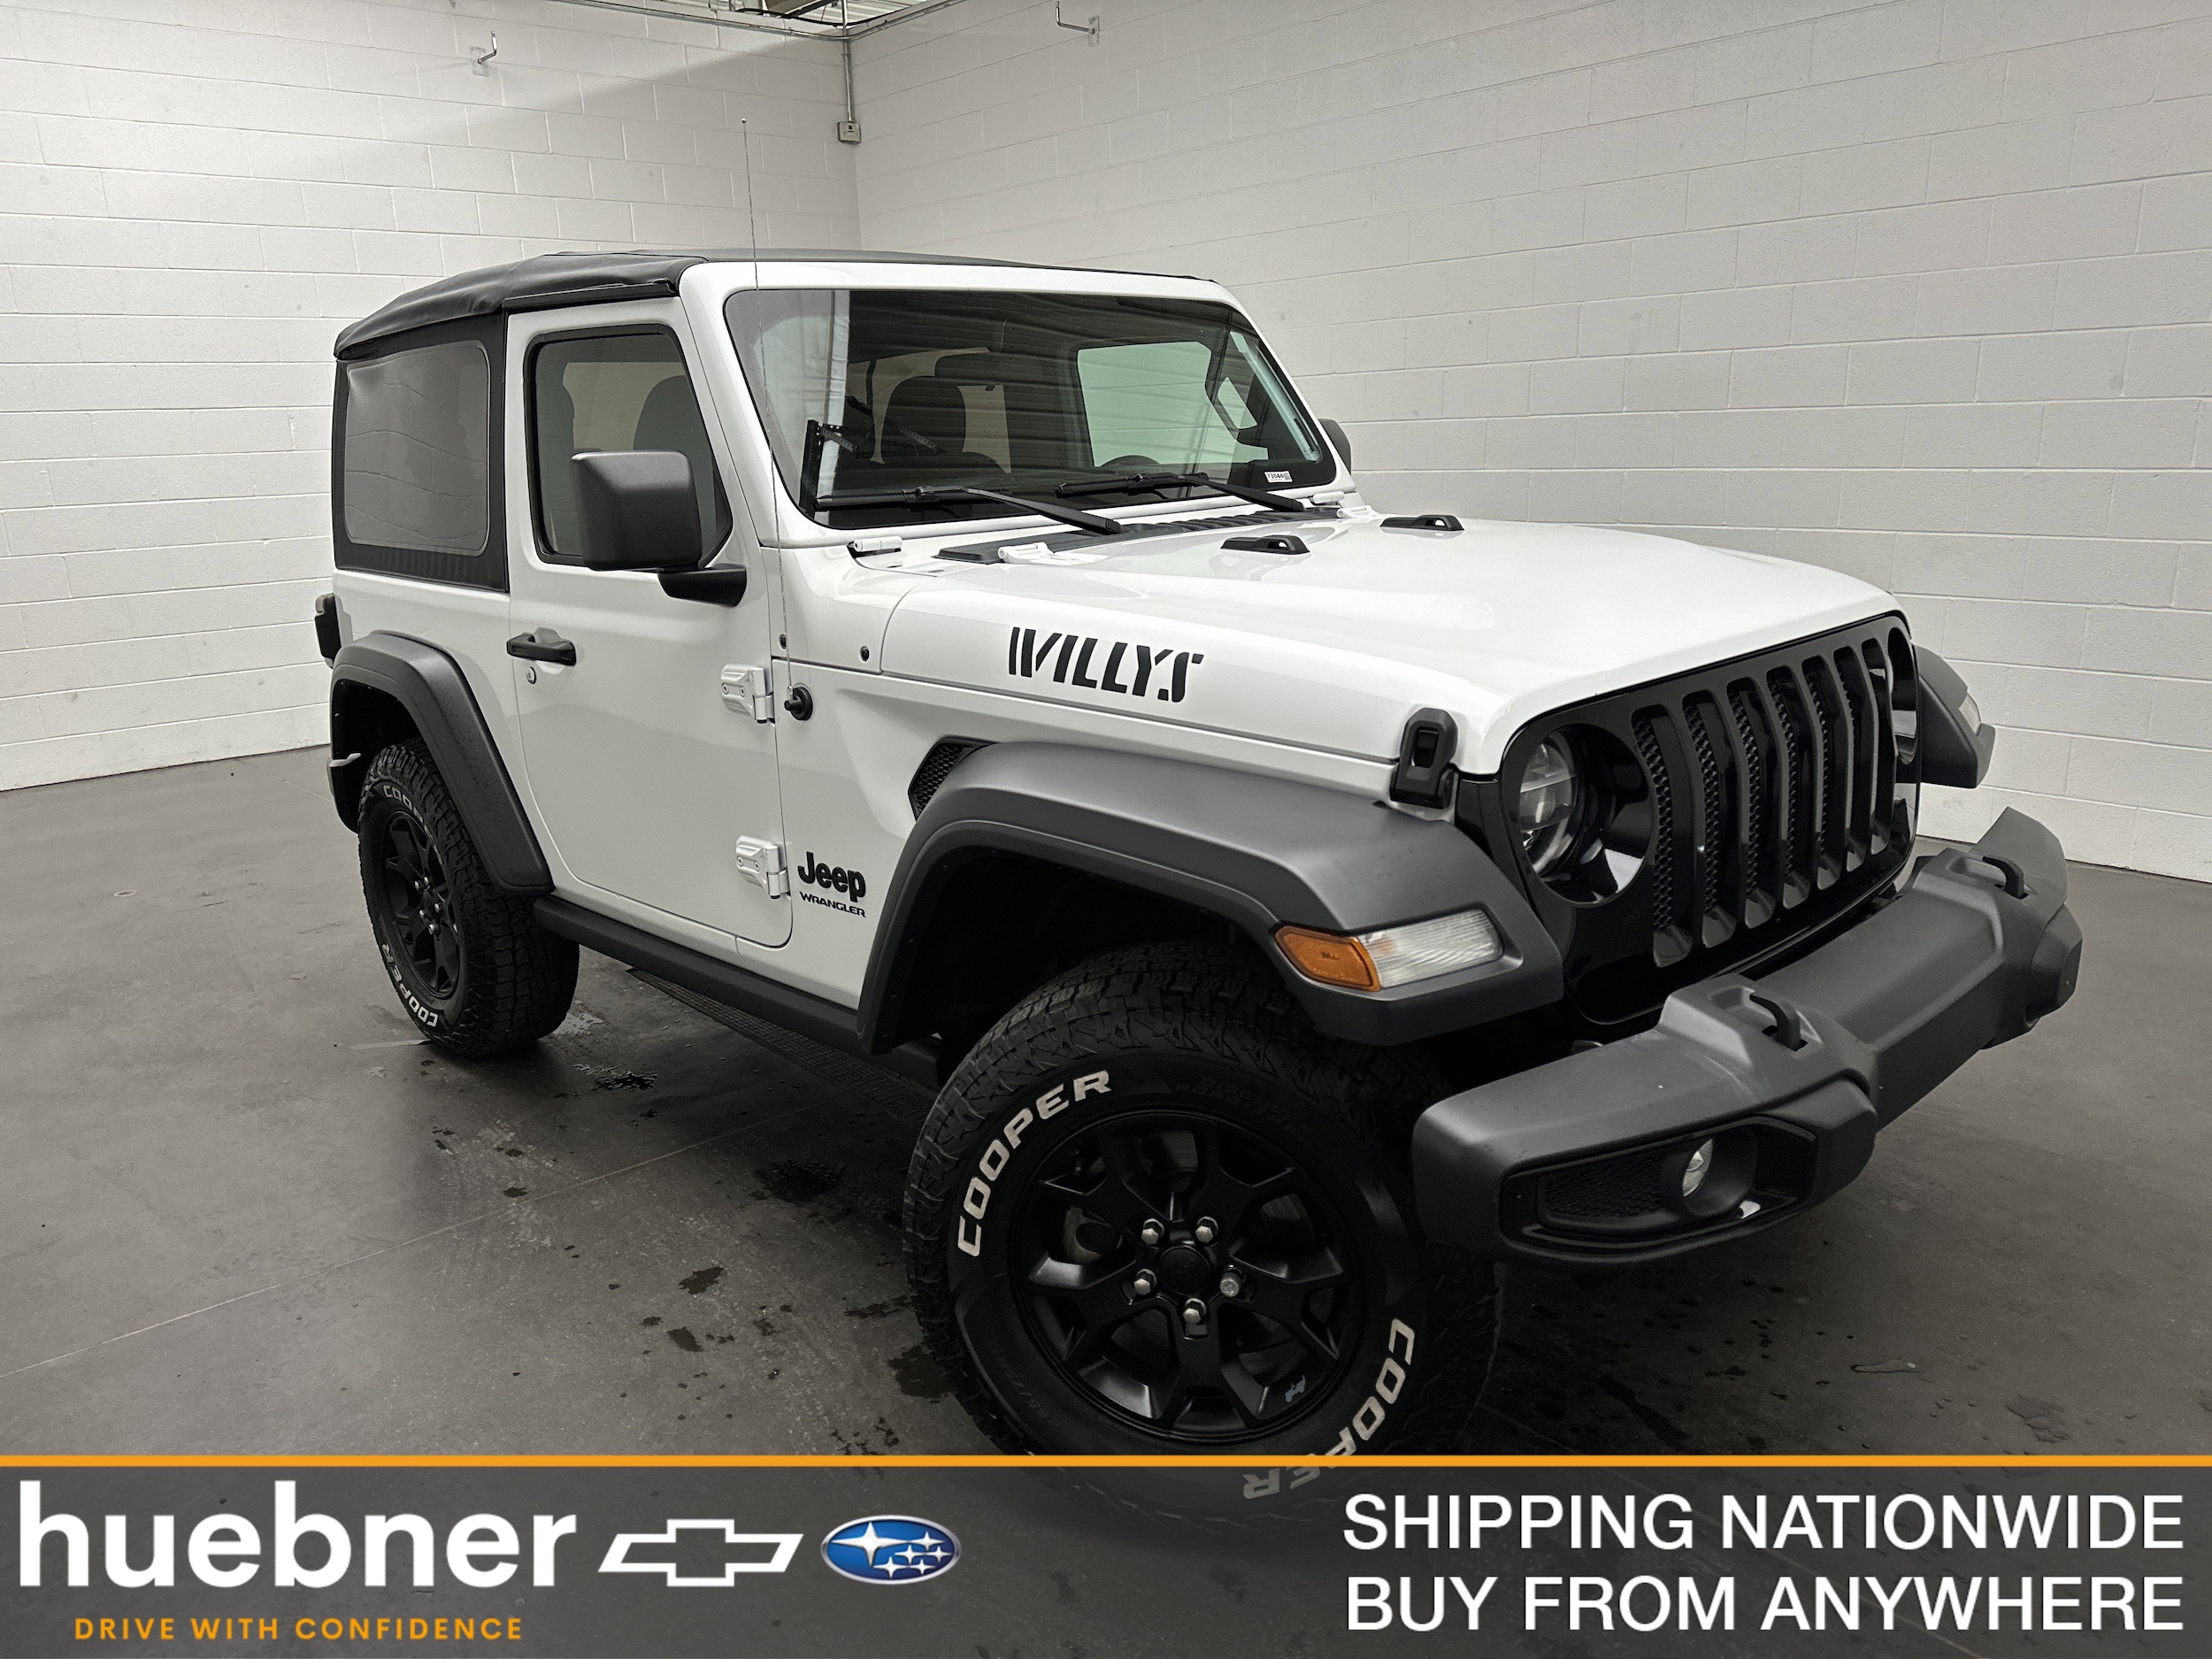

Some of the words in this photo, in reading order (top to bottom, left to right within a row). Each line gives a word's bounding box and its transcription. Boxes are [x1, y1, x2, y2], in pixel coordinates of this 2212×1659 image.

[1009, 626, 1204, 703] WILLYS
[797, 851, 866, 902] Jeep
[799, 891, 866, 918] WRANGLER
[381, 943, 439, 1027] COOPER
[957, 1070, 1111, 1257] COOPER
